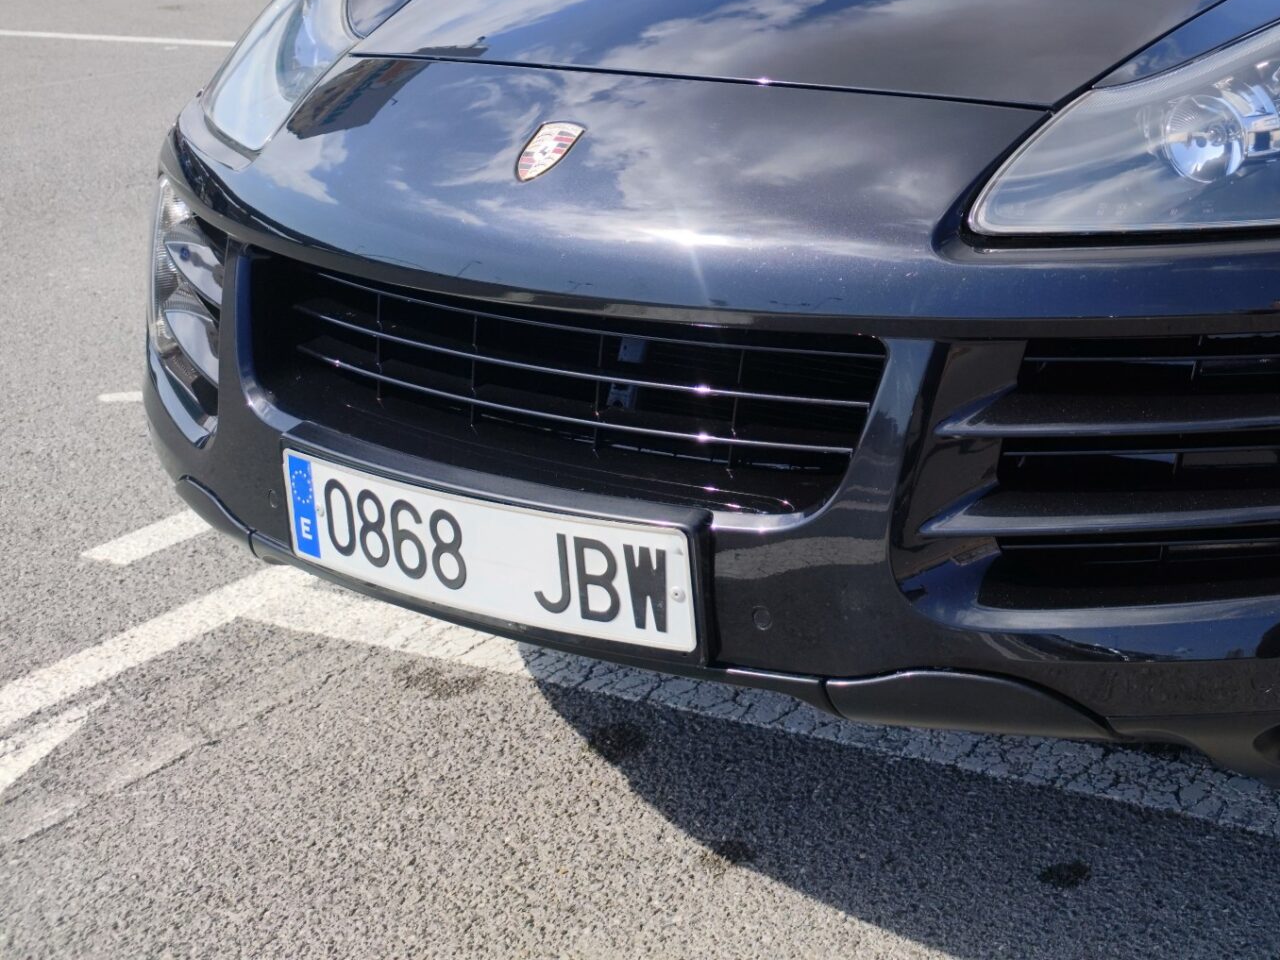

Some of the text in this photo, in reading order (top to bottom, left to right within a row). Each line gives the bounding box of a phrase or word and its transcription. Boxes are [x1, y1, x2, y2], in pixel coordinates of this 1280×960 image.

[301, 518, 313, 540] E
[324, 478, 668, 633] 0868 JBW
